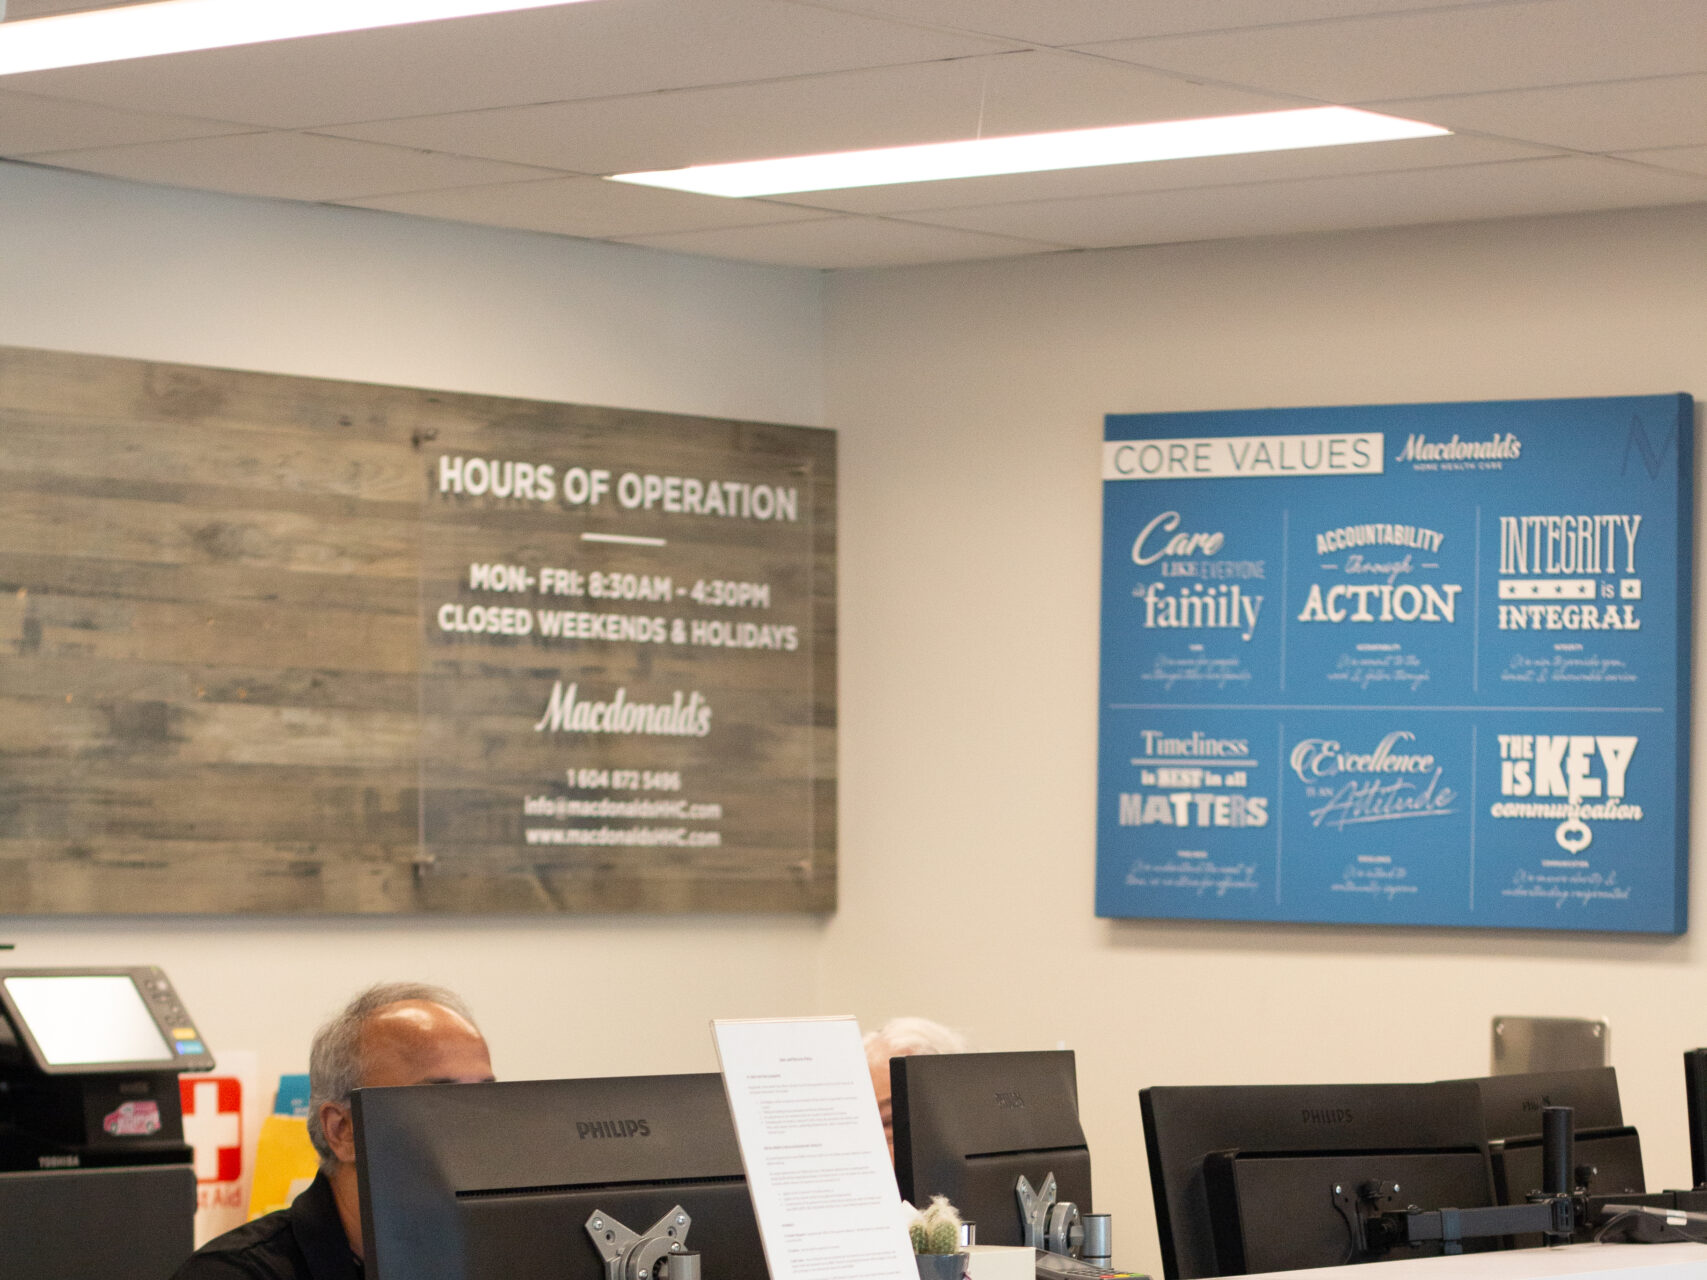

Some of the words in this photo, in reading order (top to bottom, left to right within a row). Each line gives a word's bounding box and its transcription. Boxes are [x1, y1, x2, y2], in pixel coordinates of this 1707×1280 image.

[1114, 443, 1211, 475] CORE
[1227, 438, 1371, 472] VALUES
[1395, 433, 1521, 461] Macdonald's
[1441, 462, 1476, 471] HEALTH
[1478, 461, 1503, 470] CARE
[440, 455, 556, 501] HOURS
[563, 467, 611, 506] OF
[617, 472, 798, 521] OPERATION
[1132, 511, 1224, 566] Care
[1316, 523, 1444, 556] ACCOUNTABILITY
[1499, 514, 1642, 574] INTEGRITY
[1161, 560, 1200, 577] LIKE
[1201, 560, 1266, 579] EVERYONE
[540, 567, 585, 597] FRI:
[588, 571, 672, 602] 8:30AM
[691, 579, 770, 608] 4:30PM
[1297, 583, 1462, 623] ACTION
[1601, 580, 1615, 599] is
[438, 603, 533, 636] CLOSED
[537, 609, 667, 643] WEEKENDS
[670, 618, 687, 644] &
[691, 620, 798, 651] HOLIDAYS
[1144, 582, 1264, 641] family
[1498, 605, 1641, 630] INTEGRAL
[534, 680, 712, 737] Macdonald's
[1140, 730, 1249, 756] Timeliness
[1290, 731, 1435, 784] Excellence
[1157, 768, 1203, 789] BEST
[1205, 770, 1222, 787] in
[1225, 771, 1247, 787] all
[1498, 735, 1533, 759] THE
[1535, 735, 1638, 798] KEY
[1501, 761, 1533, 797] IS
[1119, 792, 1269, 827] MATTERS
[1491, 798, 1643, 821] communication
[576, 1119, 650, 1139] PHILIPS
[1302, 1108, 1353, 1124] PHILIPS
